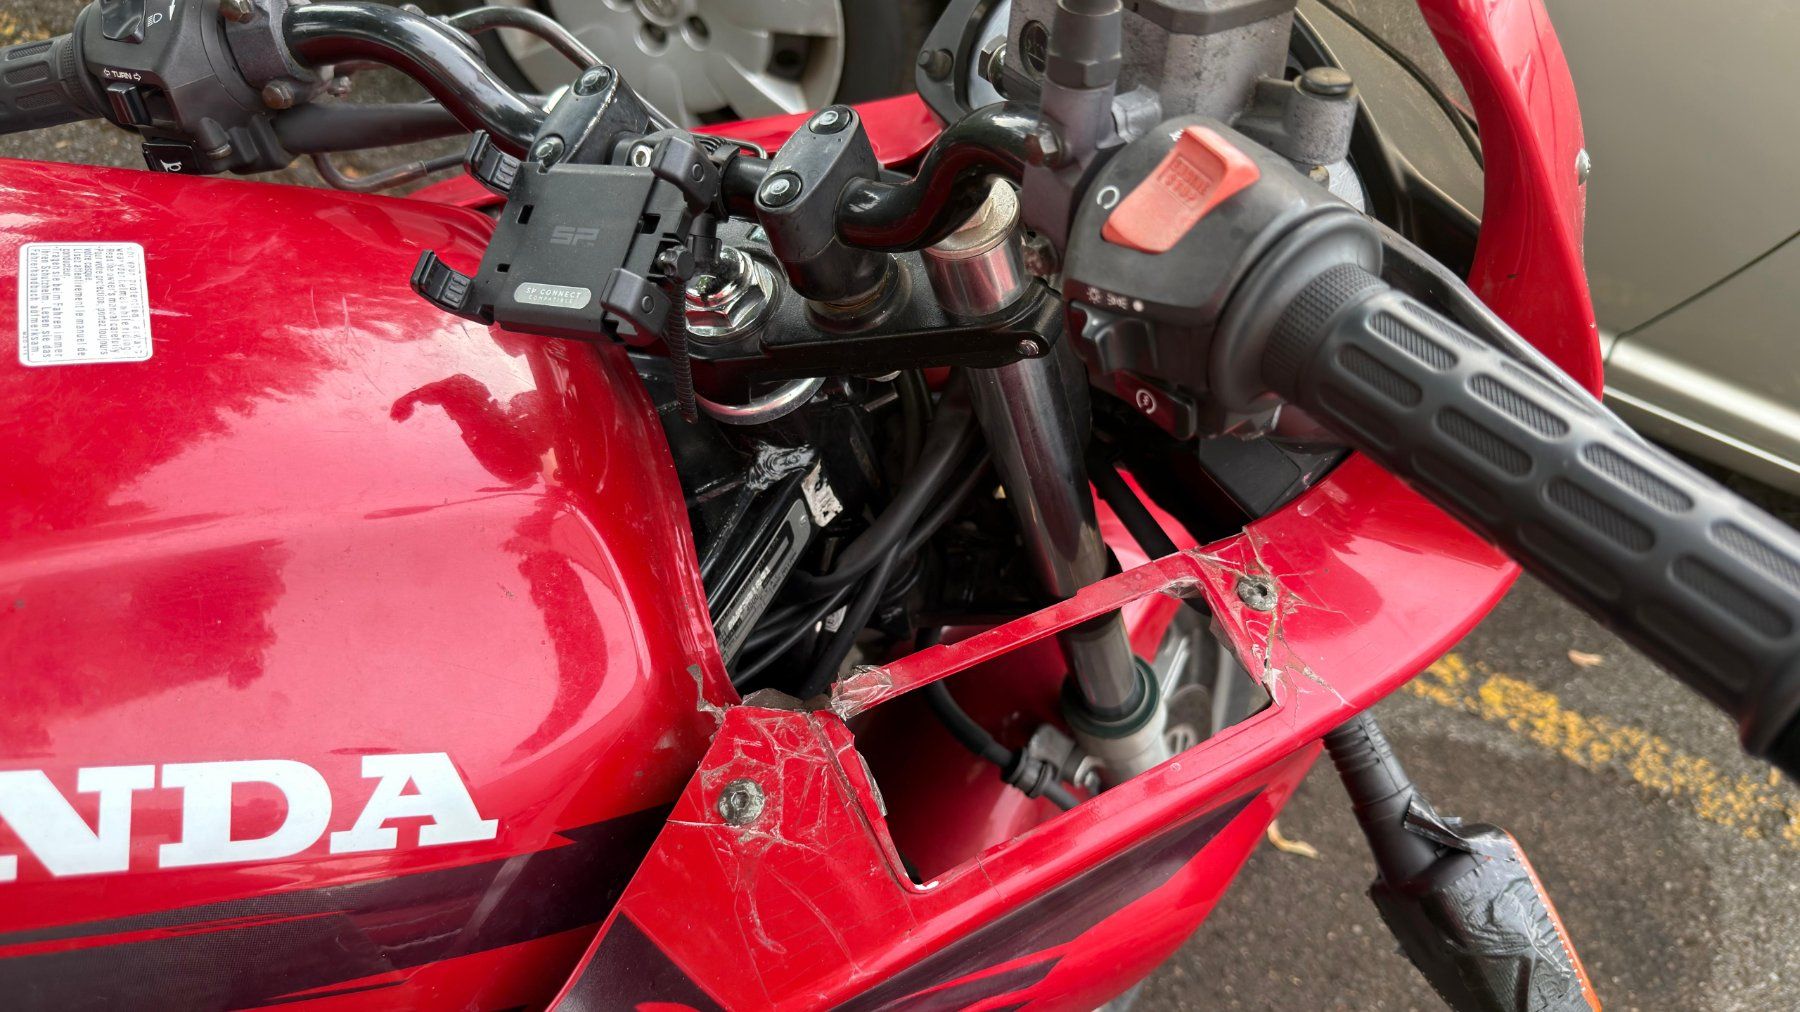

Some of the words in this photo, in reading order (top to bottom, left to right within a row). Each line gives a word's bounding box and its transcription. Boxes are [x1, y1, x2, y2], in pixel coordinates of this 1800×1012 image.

[111, 70, 133, 80] TURN
[549, 225, 600, 246] SP
[53, 284, 63, 300] beim
[540, 288, 582, 299] CONNECT
[41, 307, 51, 327] Lesen
[53, 303, 63, 329] Fahren
[76, 319, 86, 345] manuel
[97, 328, 109, 355] toujours
[53, 332, 63, 357] immer
